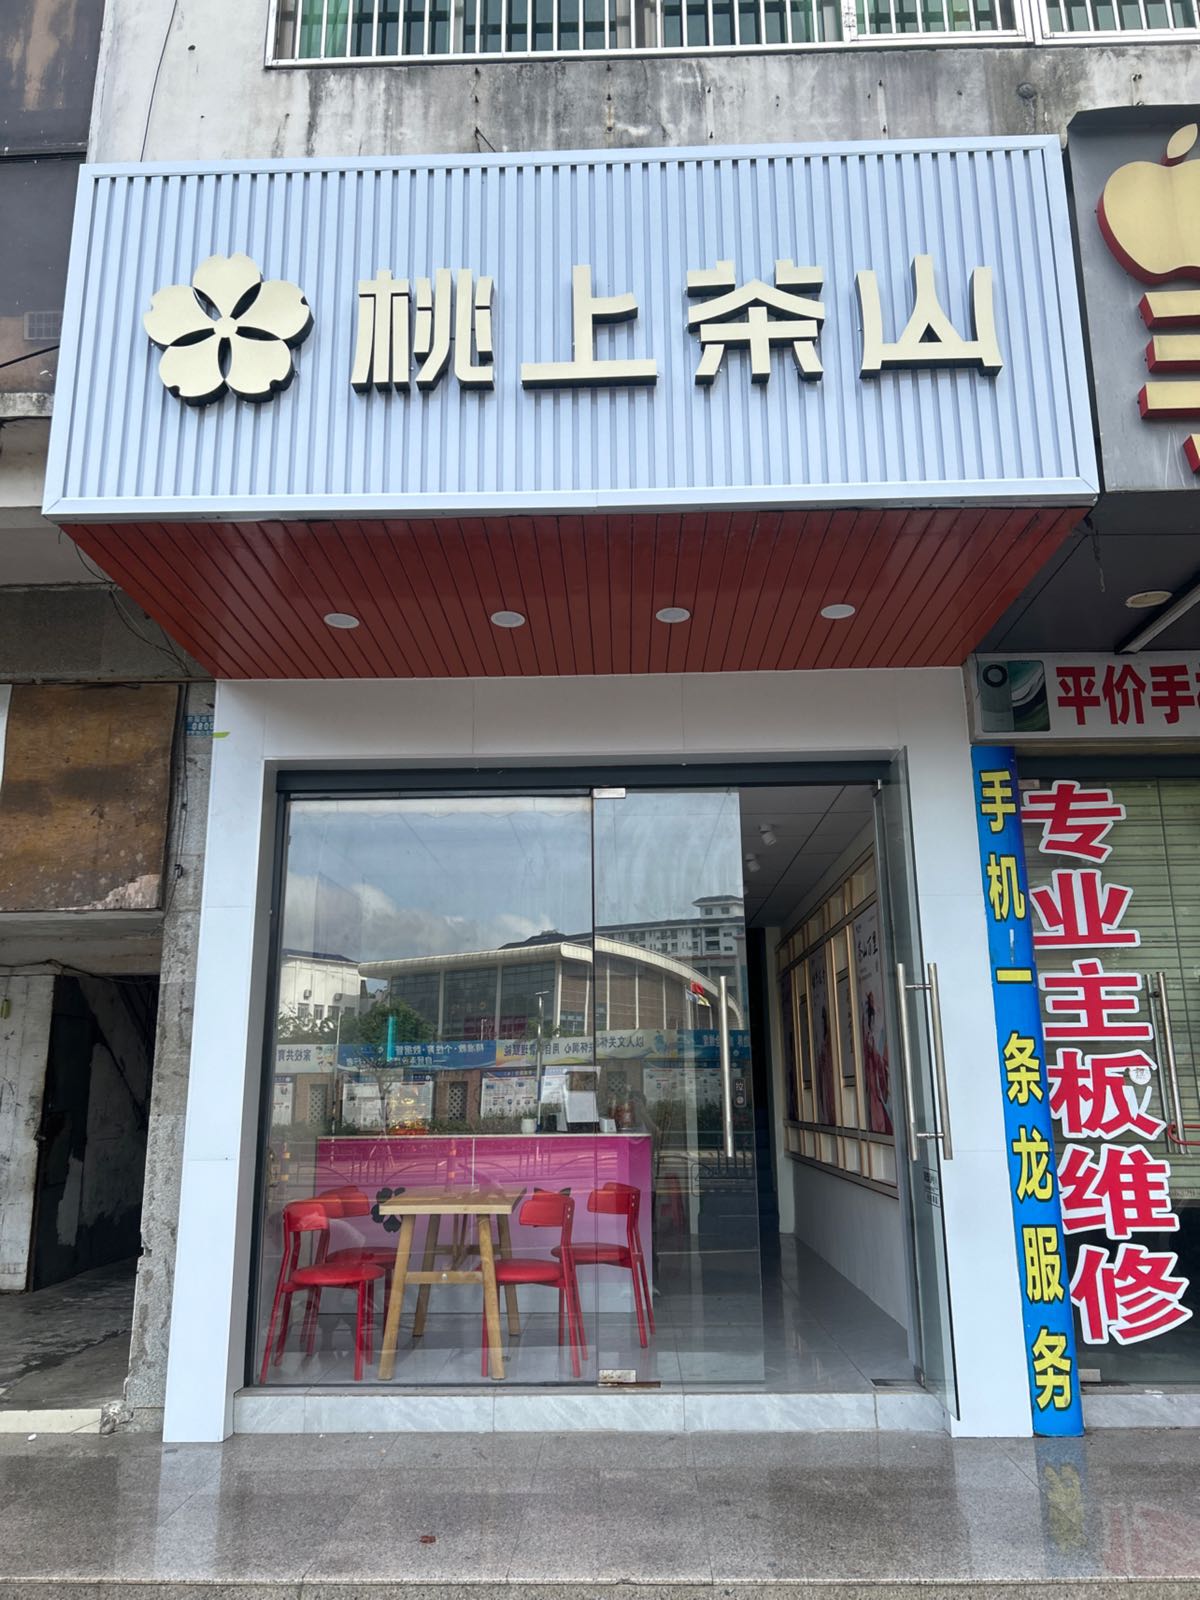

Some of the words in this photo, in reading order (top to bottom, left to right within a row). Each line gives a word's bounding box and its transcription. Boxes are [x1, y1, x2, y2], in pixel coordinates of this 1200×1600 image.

[1056, 664, 1200, 726] 平价手
[979, 769, 1072, 1411] 手机一条龙服务
[1021, 780, 1192, 1345] 专业主板维修
